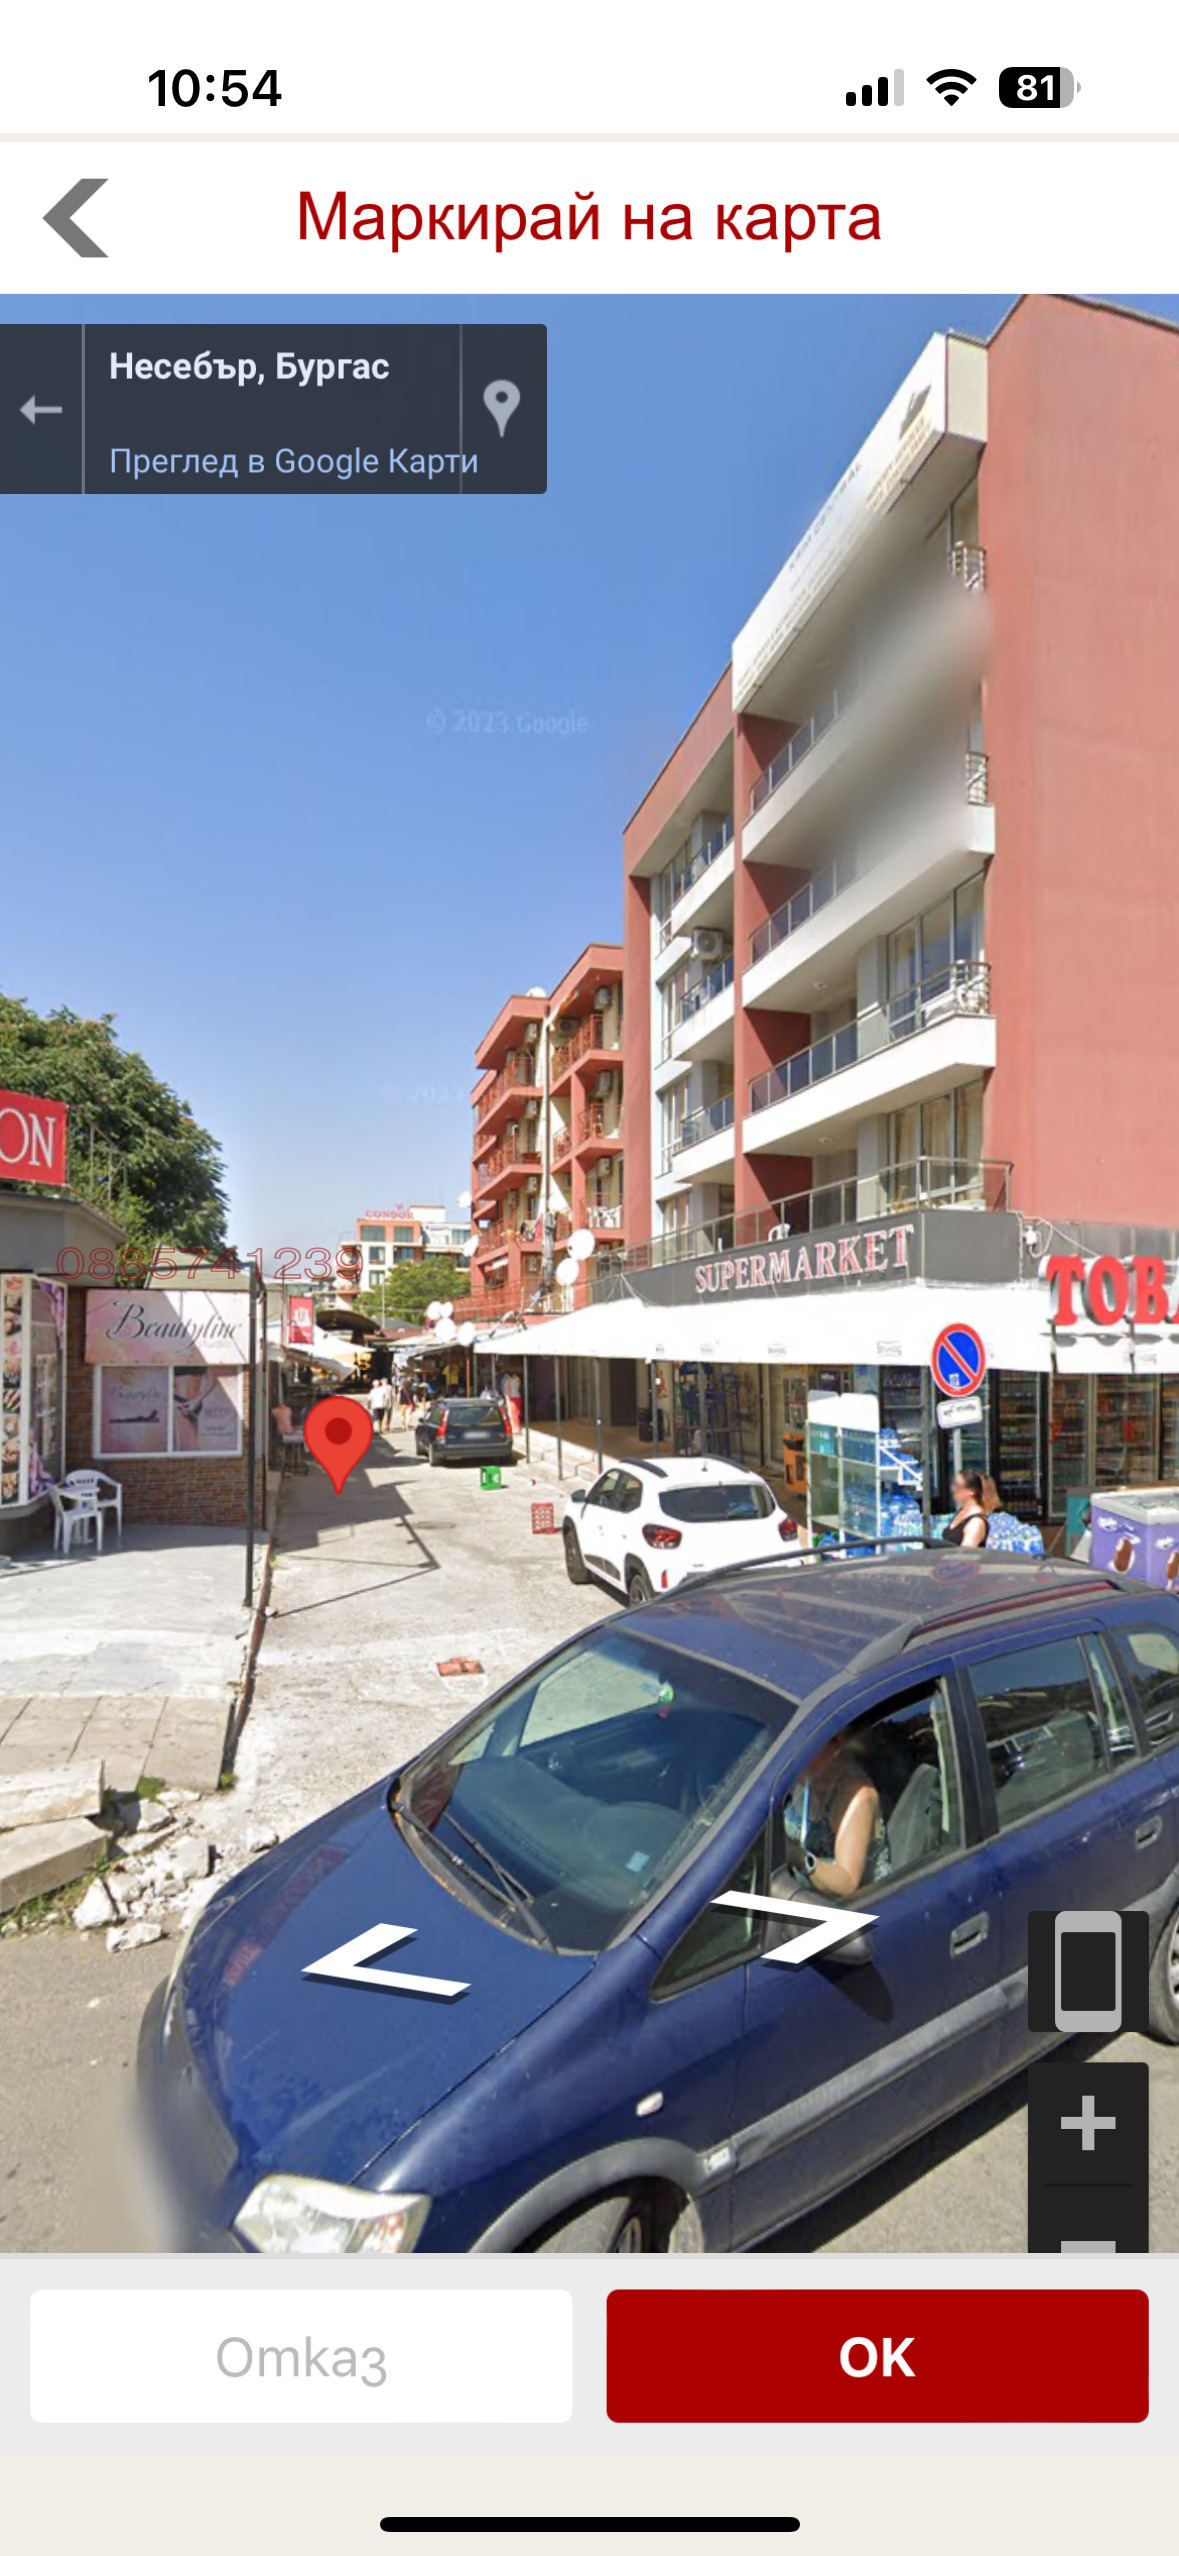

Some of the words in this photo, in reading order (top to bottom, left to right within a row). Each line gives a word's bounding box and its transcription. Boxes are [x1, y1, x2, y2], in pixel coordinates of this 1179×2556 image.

[149, 69, 282, 107] 10:54
[1017, 74, 1053, 101] 81
[300, 191, 599, 253] Маркирай
[625, 204, 692, 240] на
[717, 204, 881, 253] карта
[111, 350, 264, 386] Несебър,
[277, 352, 389, 387] Бургас
[111, 448, 238, 480] Преглед
[249, 454, 264, 473] в
[276, 447, 379, 480] Google
[390, 448, 478, 480] Карти
[0, 1108, 56, 1168] ON
[365, 1209, 414, 1219] CONDOR
[695, 1224, 914, 1293] SUPERMARKET
[1046, 1255, 1179, 1326] TOB
[217, 2336, 387, 2388] Отказ
[840, 2337, 916, 2378] OK
